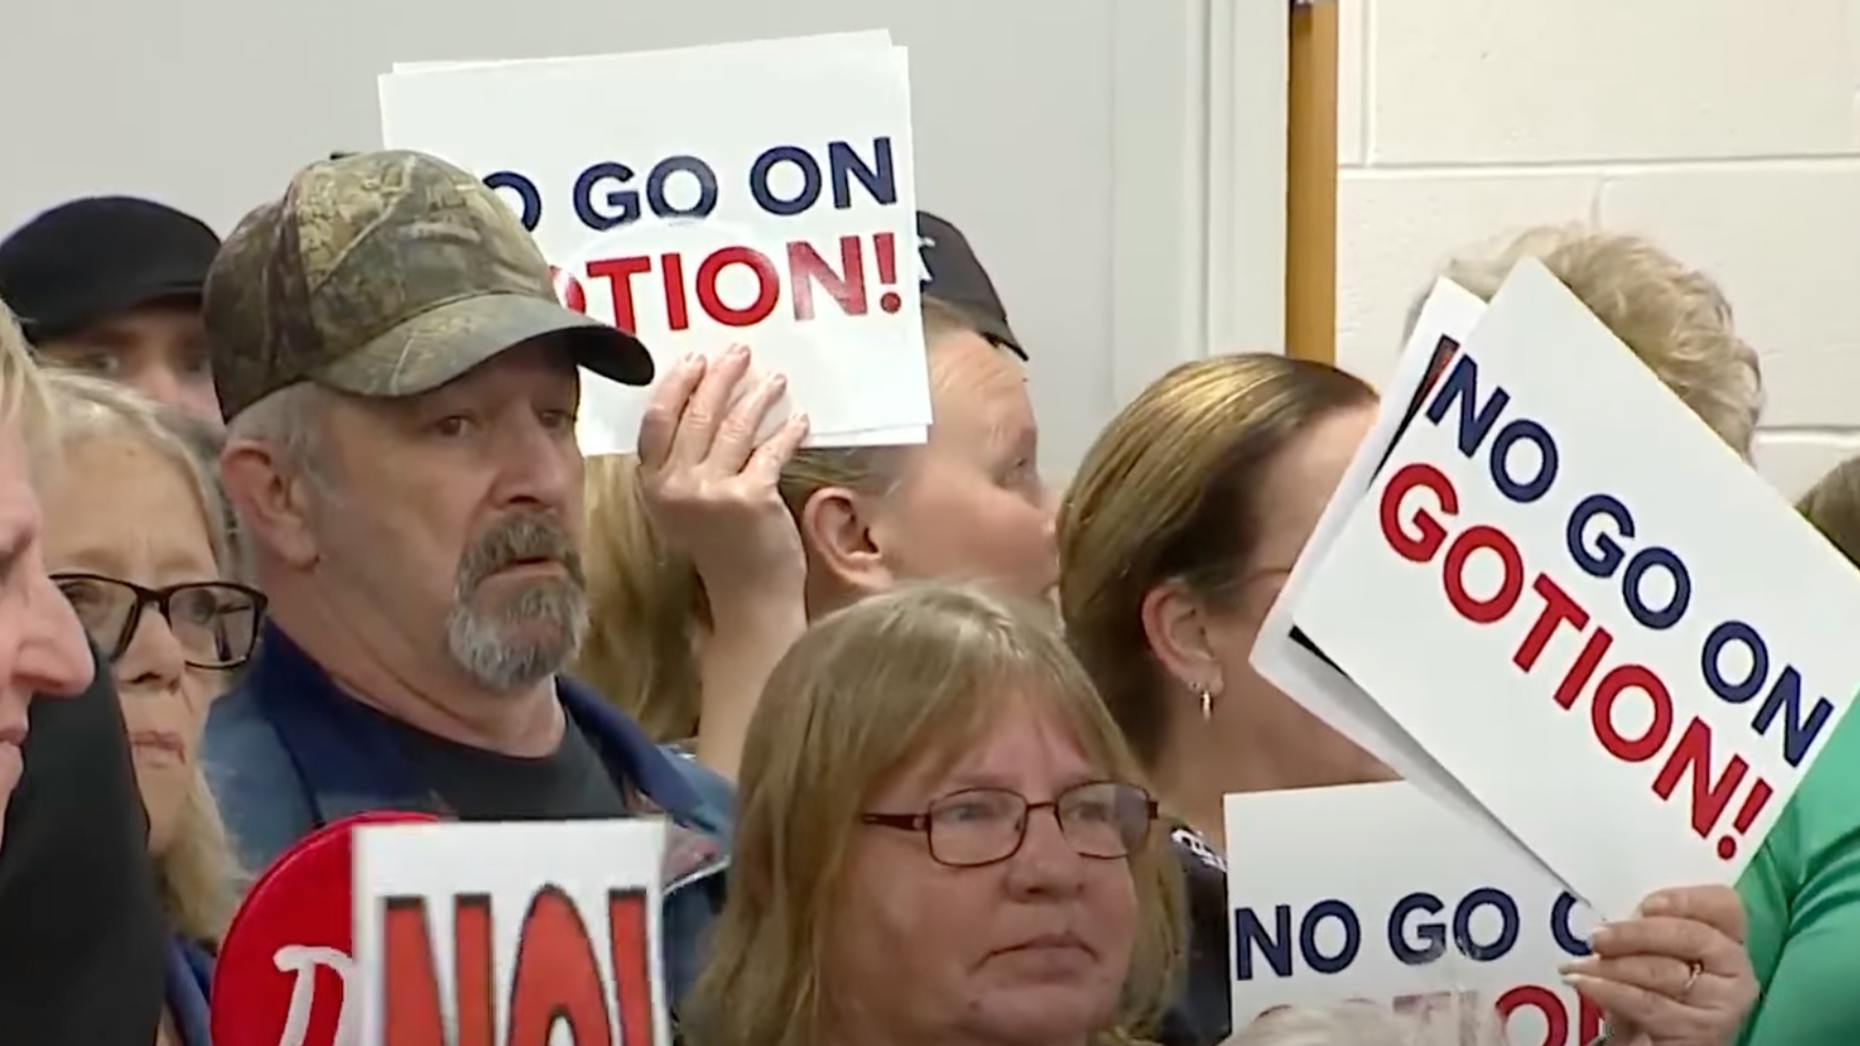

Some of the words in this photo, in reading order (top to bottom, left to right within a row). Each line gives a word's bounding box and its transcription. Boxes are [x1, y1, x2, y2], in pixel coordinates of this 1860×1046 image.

[482, 170, 541, 232] O
[572, 155, 718, 231] GO
[749, 136, 898, 216] ON
[546, 232, 902, 336] TION!
[1426, 354, 1559, 503] NO
[1566, 493, 1692, 630] GO
[1700, 620, 1834, 768] ON
[1379, 463, 1773, 860] GOTION!
[1234, 899, 1361, 980] NO
[1388, 887, 1519, 965] GO
